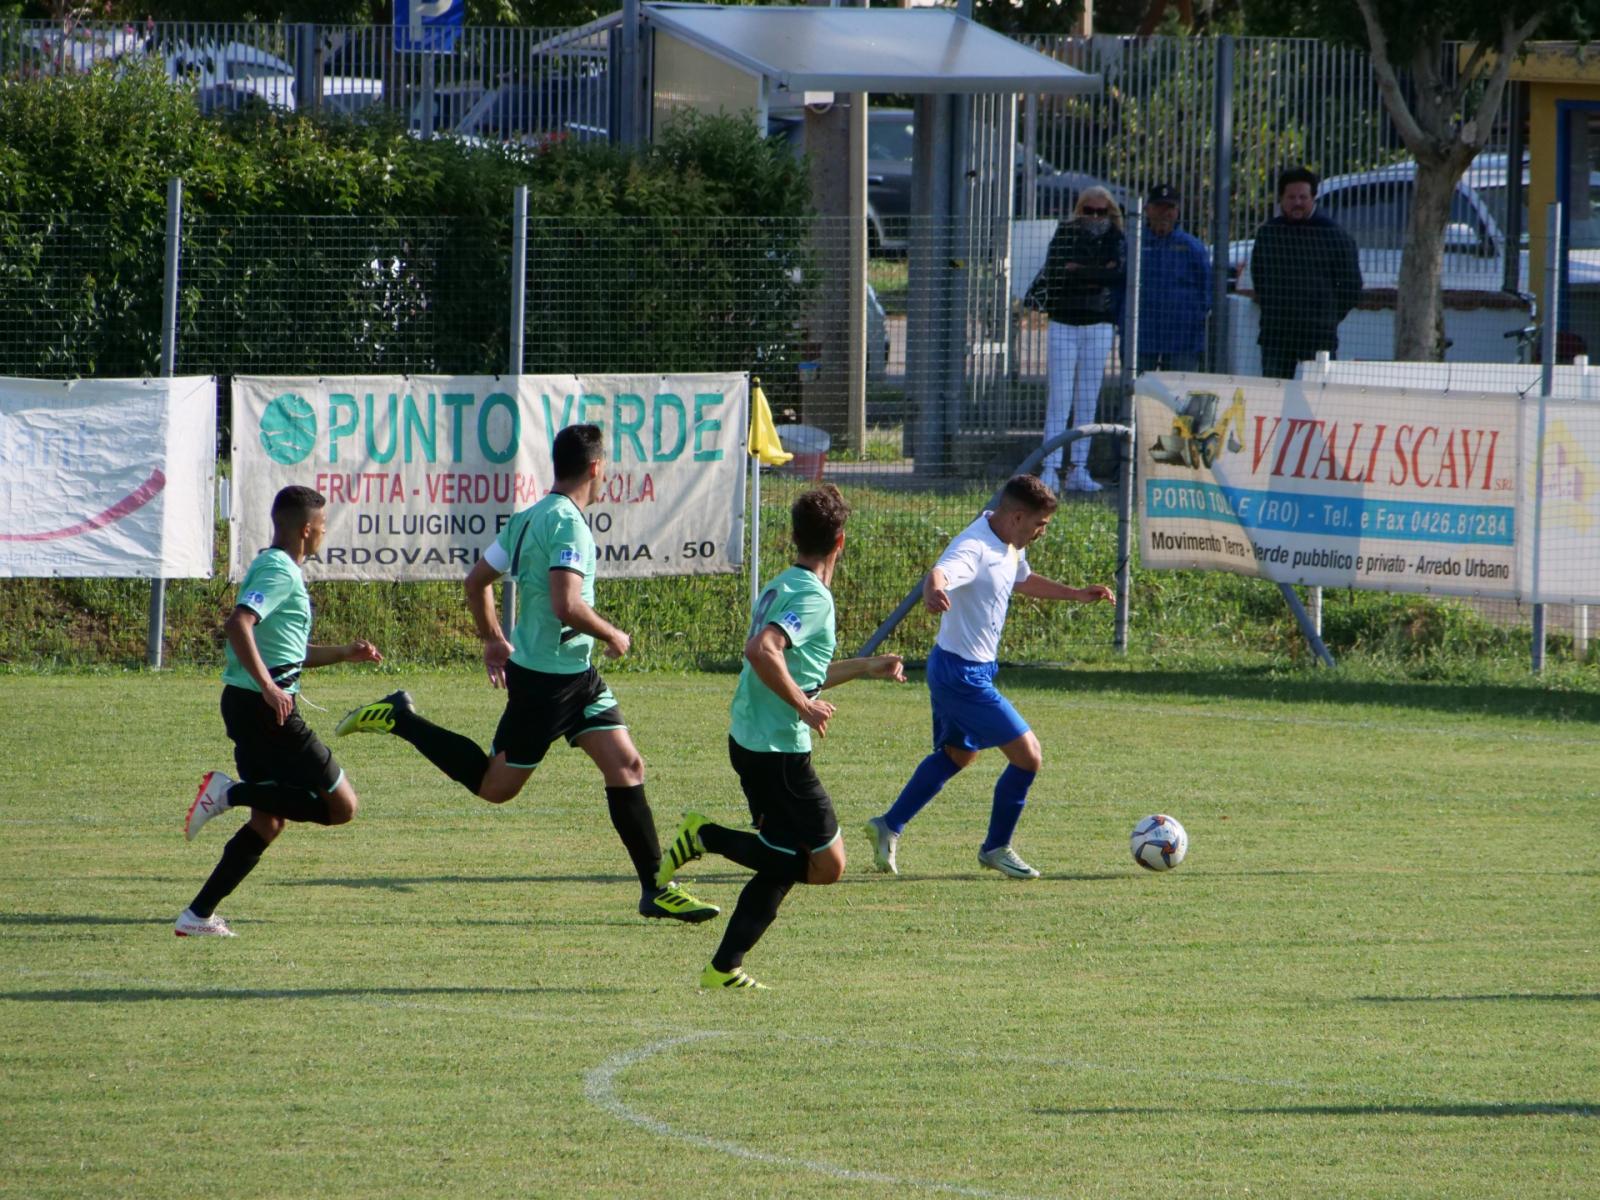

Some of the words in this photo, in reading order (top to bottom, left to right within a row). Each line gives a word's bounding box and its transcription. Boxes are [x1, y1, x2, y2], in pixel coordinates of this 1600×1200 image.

[409, 0, 453, 41] P
[328, 392, 521, 464] PUNTO
[1251, 415, 1387, 483] VITALI
[1389, 424, 1500, 490] SCAVI
[316, 472, 404, 504] FRUTTA
[426, 472, 537, 504] VERDURA
[359, 514, 379, 535] DI
[389, 513, 486, 535] LUIGINO
[1152, 487, 1207, 511] PORTO
[1258, 499, 1300, 528] (RO)
[1323, 504, 1353, 528] Tel.
[1360, 511, 1369, 529] e
[1376, 508, 1404, 531] Fax
[1411, 511, 1507, 537] 0426.81284
[682, 541, 716, 559] 50
[1152, 531, 1222, 554] Movimento
[1222, 536, 1246, 557] Terra
[1292, 549, 1352, 571] pubblico
[1355, 553, 1364, 570] e
[1365, 553, 1407, 576] privato
[1415, 554, 1461, 577] Arredo
[1465, 558, 1510, 579] Urbano
